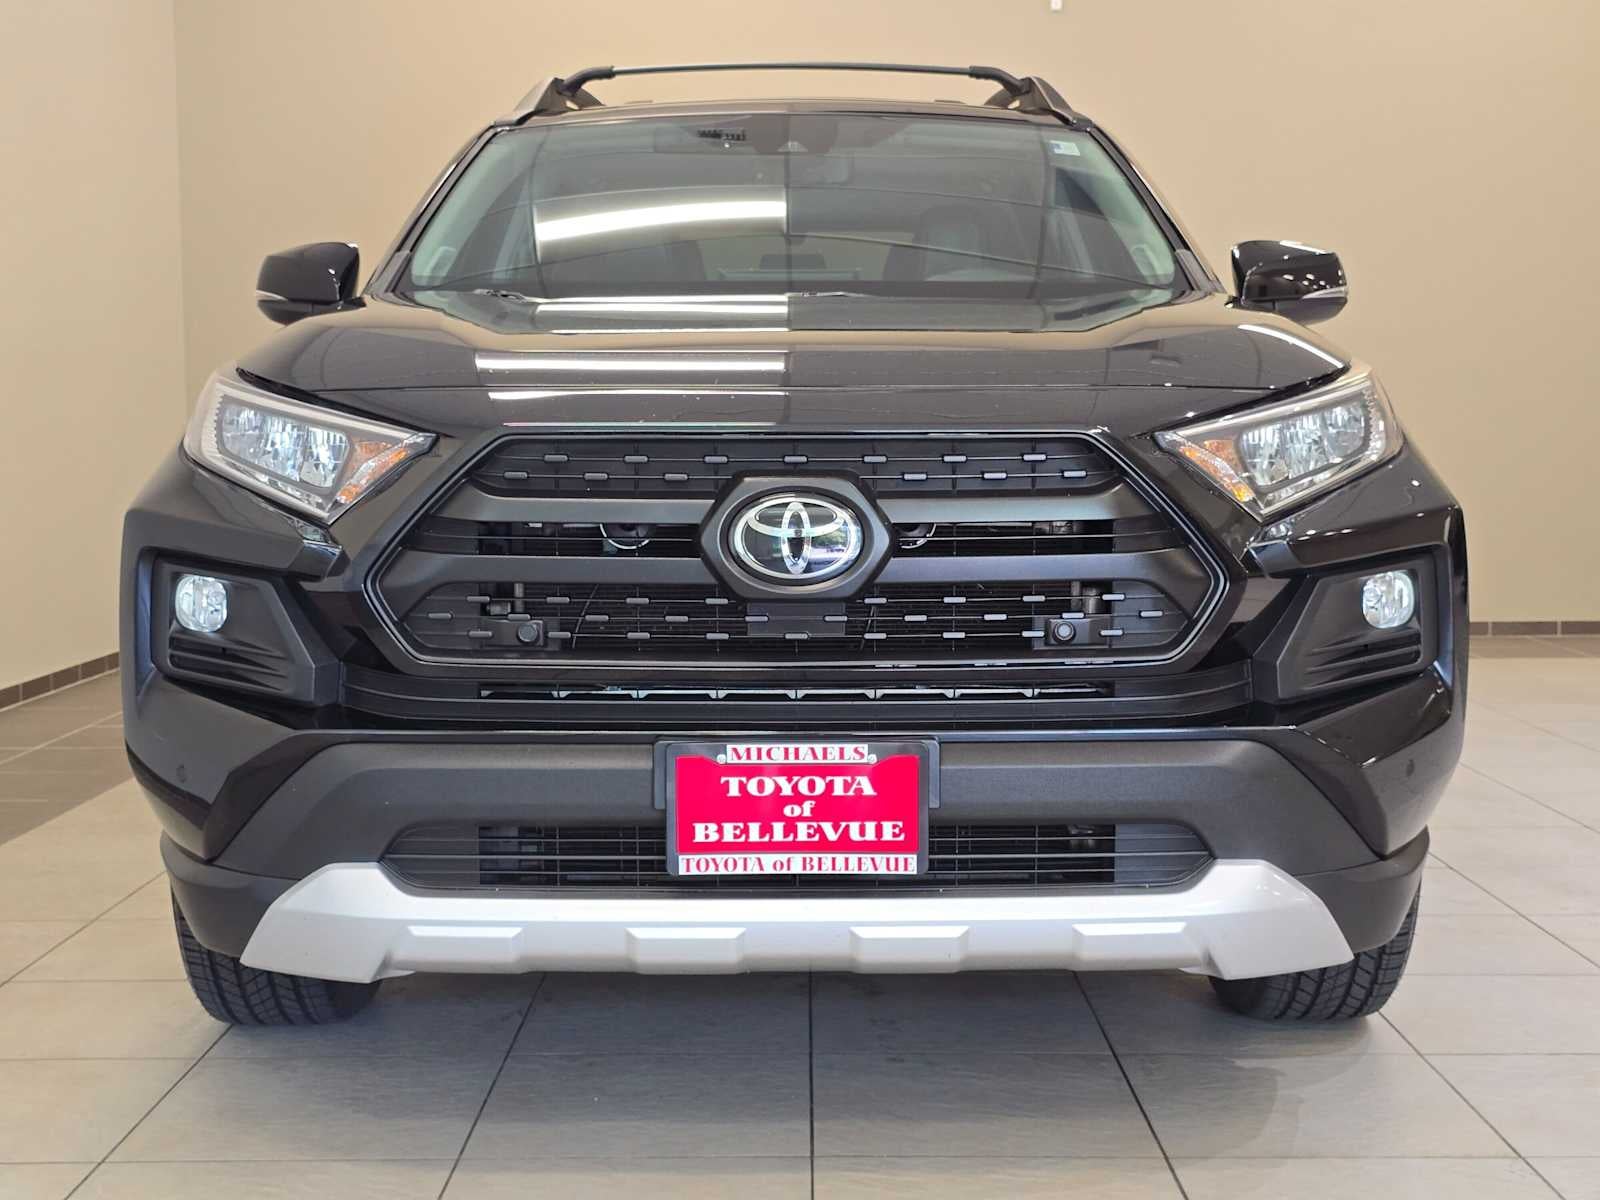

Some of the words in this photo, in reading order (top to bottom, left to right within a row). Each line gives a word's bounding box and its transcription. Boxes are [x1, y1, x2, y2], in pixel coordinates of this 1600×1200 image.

[729, 746, 867, 761] MICHAELS
[720, 776, 877, 797] TOYOTA
[783, 801, 816, 817] of
[693, 821, 905, 842] BELLEVUE
[681, 857, 766, 873] TOYOTA
[772, 857, 794, 872] of
[801, 857, 915, 872] BELLEVUE
